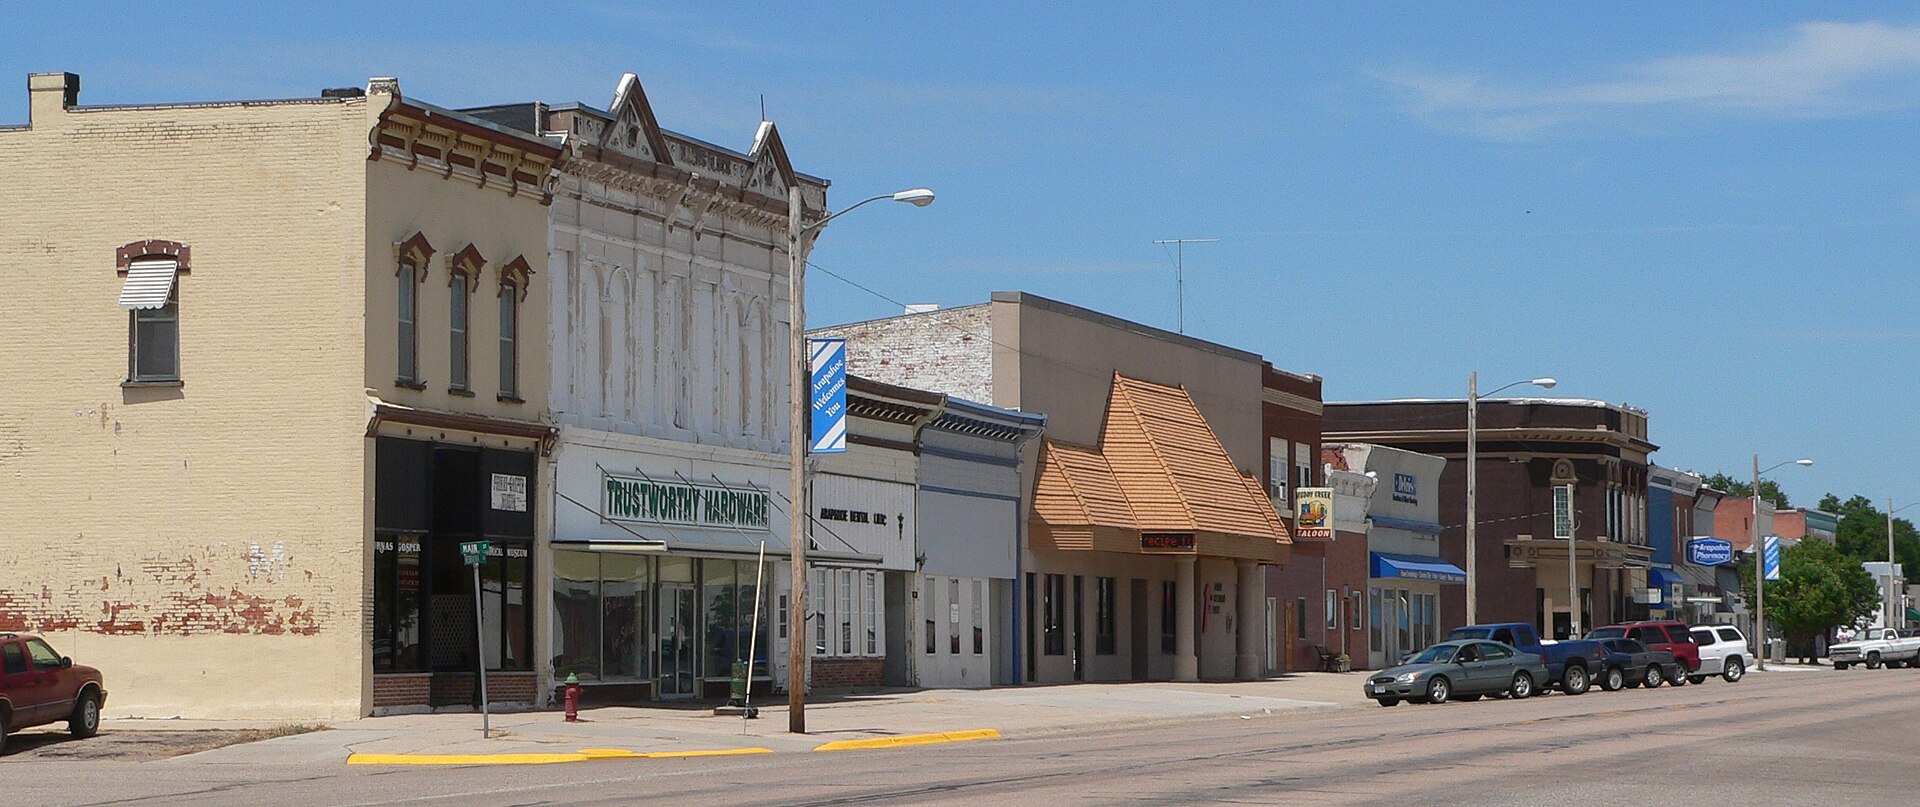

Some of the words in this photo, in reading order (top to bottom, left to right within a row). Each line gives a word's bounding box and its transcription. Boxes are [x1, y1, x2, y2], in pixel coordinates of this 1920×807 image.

[814, 359, 844, 394] Arapahoe
[813, 377, 845, 411] Welcomes
[825, 401, 842, 418] You
[607, 480, 700, 522] TRUSTWORTHY
[704, 489, 768, 527] HARDWARE
[462, 544, 478, 553] MAIN
[507, 548, 528, 558] MUSEUM
[1697, 551, 1729, 561] Pharmacy
